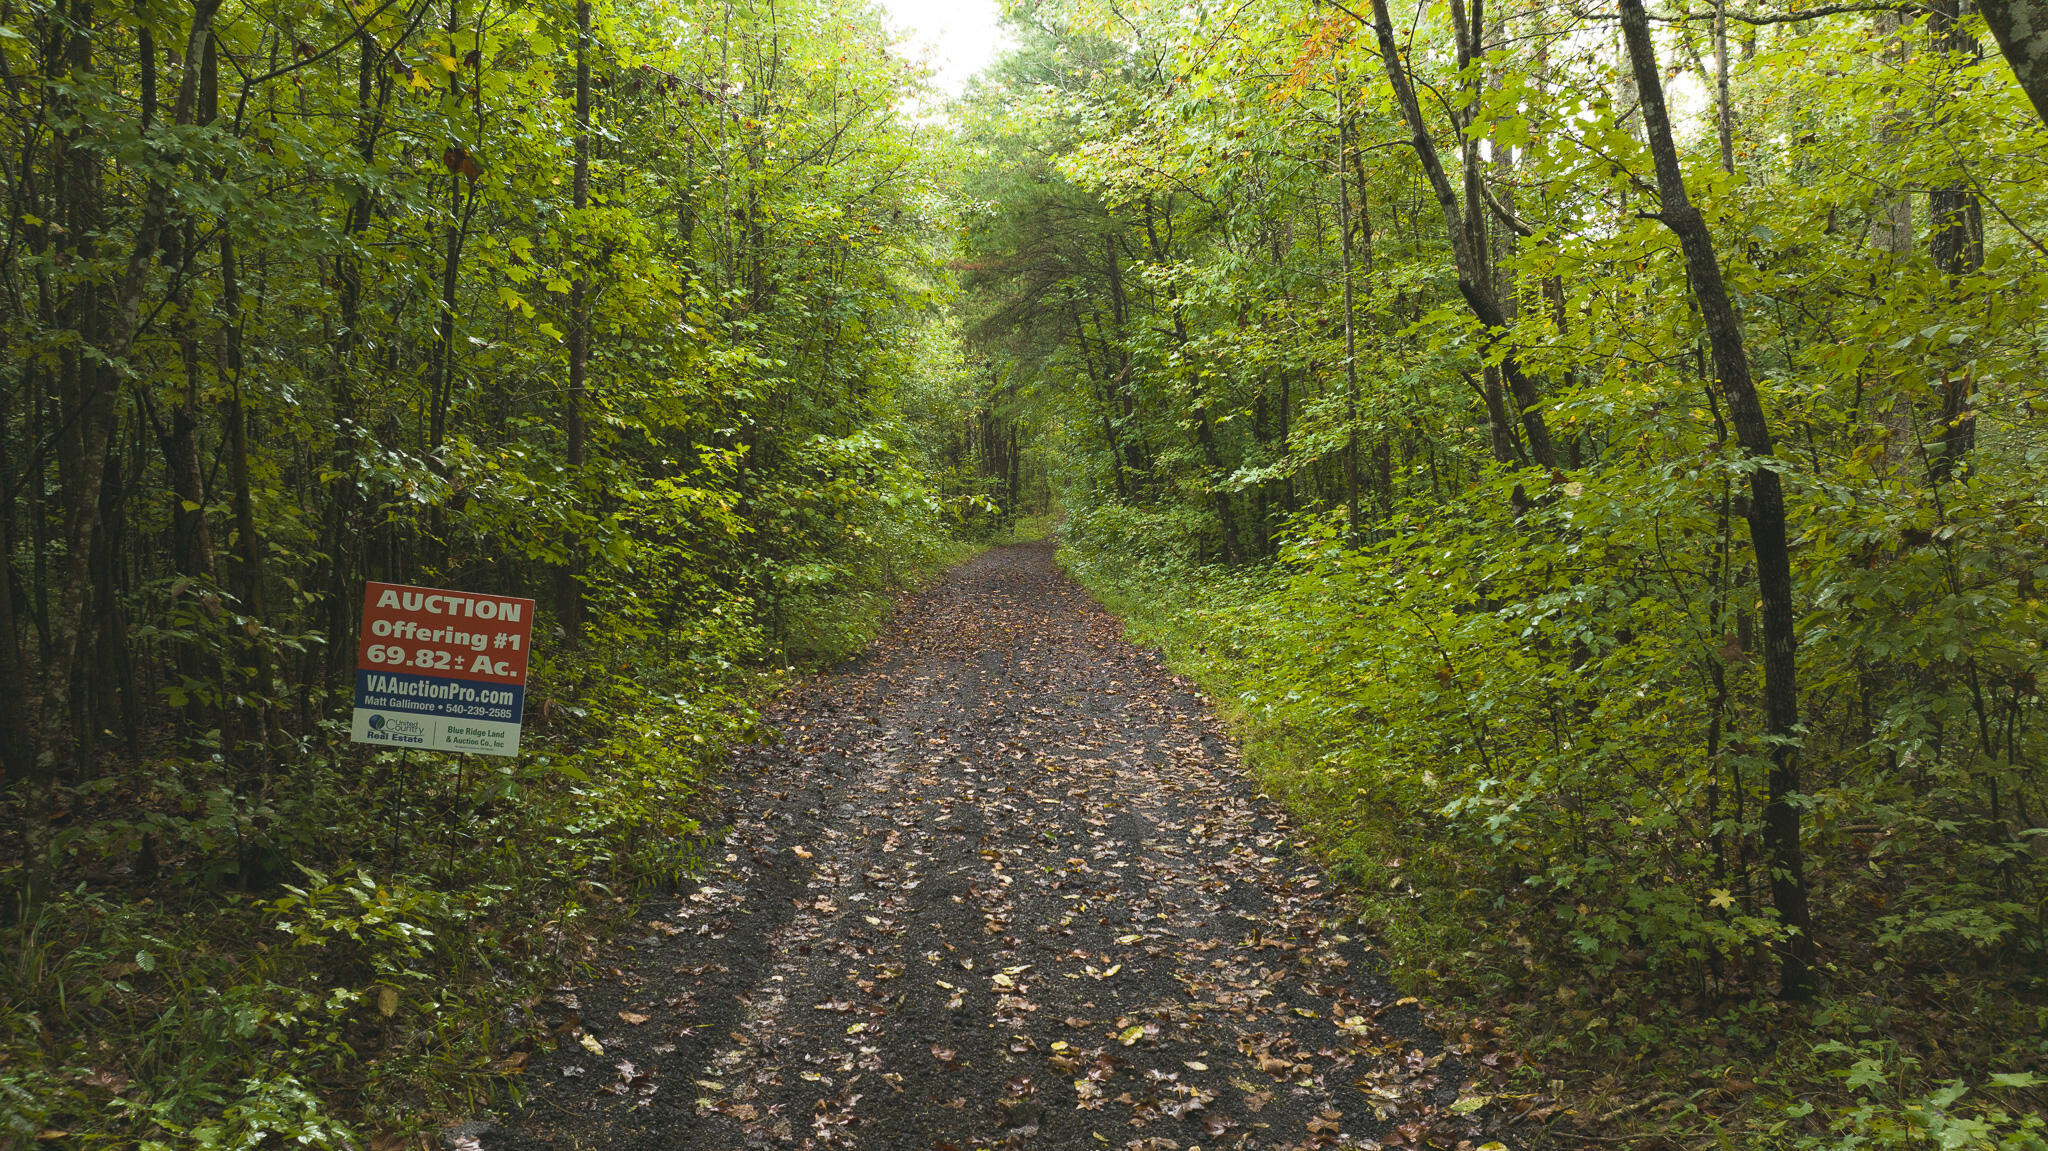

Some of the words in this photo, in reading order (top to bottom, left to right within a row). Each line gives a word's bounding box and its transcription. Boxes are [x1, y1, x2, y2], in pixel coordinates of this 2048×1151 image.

[376, 590, 521, 622] AUCTION
[372, 620, 488, 651] Offering
[494, 632, 520, 650] #1
[470, 655, 518, 677] Ac.
[367, 674, 513, 705] VAAuctionPro.com
[365, 696, 387, 706] Matt
[389, 698, 435, 711] Gallimore
[446, 704, 512, 718] 540-239-2585
[367, 731, 388, 740] Real
[392, 734, 423, 744] Estate
[386, 718, 424, 735] Country
[447, 726, 464, 734] Blue
[466, 728, 486, 737] Ridge
[488, 729, 504, 738] Land
[453, 737, 479, 746] Auction
[494, 740, 504, 748] Inc
